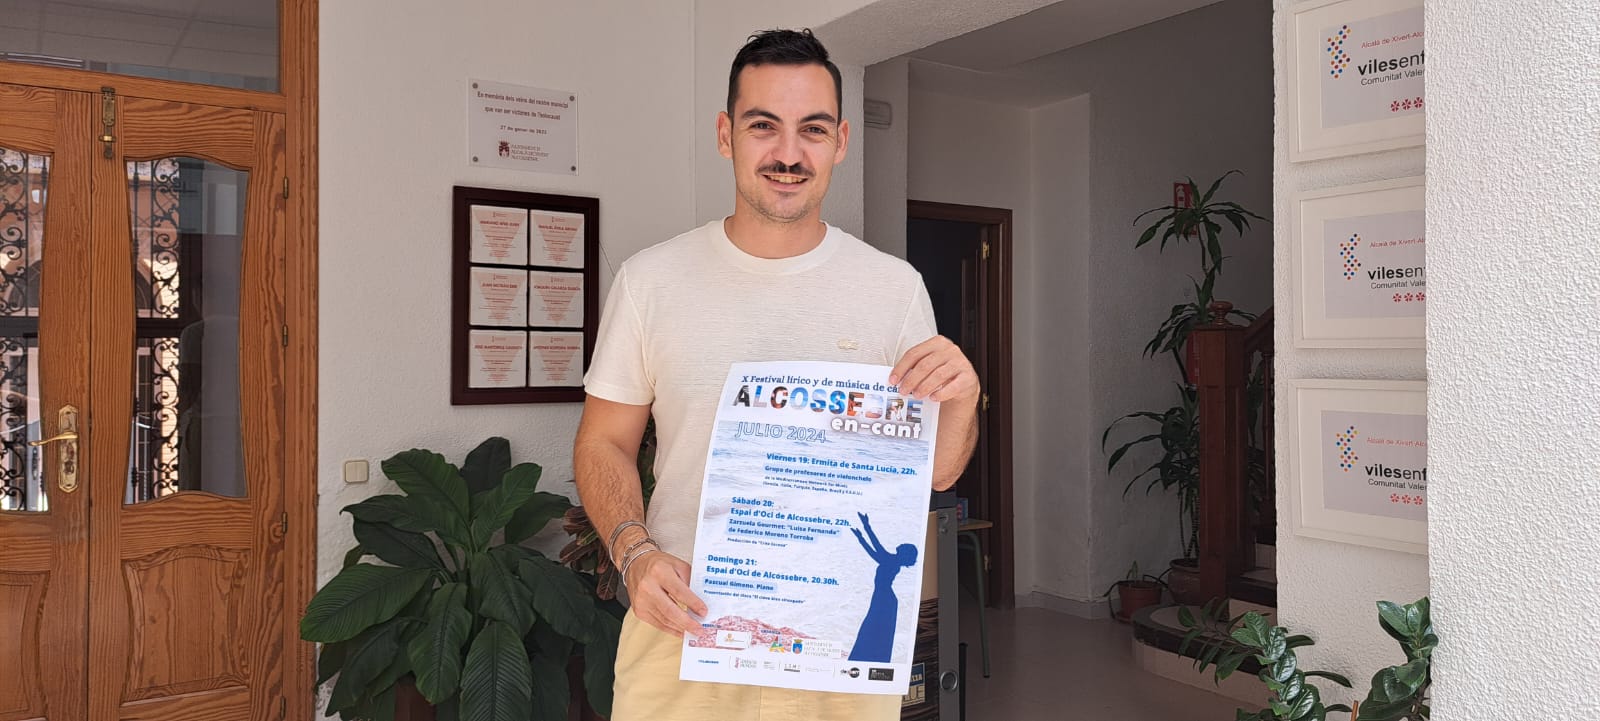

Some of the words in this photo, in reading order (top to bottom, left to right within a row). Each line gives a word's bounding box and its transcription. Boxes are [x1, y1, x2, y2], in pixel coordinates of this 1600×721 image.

[1360, 72, 1402, 86] Comunitat
[1368, 266, 1426, 280] vilesen
[1370, 281, 1408, 289] Comunitat
[750, 376, 785, 384] Festival
[786, 376, 811, 385] lírico
[812, 378, 820, 387] y
[822, 378, 833, 386] de
[836, 378, 870, 390] música
[873, 382, 885, 392] de
[733, 385, 924, 424] ALCOSSEBRE
[735, 422, 783, 439] JULIO
[786, 426, 826, 443] 2024
[831, 418, 922, 439] en-cant
[766, 453, 797, 463] Viernes
[798, 457, 810, 465] 19:
[812, 458, 838, 467] Ermita
[852, 462, 874, 471] Santa
[876, 465, 899, 474] Lucía,
[900, 468, 918, 476] 22h.
[764, 466, 784, 474] Grupo
[794, 468, 826, 478] profesores
[836, 474, 872, 482] violonchelo
[1368, 478, 1406, 489] Comunitat
[732, 496, 761, 506] Sábado
[763, 500, 774, 508] 20:
[730, 508, 752, 517] Espai
[753, 509, 774, 519] d'Oci
[786, 514, 833, 526] Alcossebre,
[834, 518, 852, 527] 22h.
[728, 519, 756, 527] Zarzuela
[756, 521, 786, 530] Gourmet:
[787, 524, 807, 532] "Luisa
[808, 526, 840, 535] Fernanda"
[737, 528, 764, 536] Federico
[764, 530, 788, 538] Moreno
[790, 533, 814, 541] Torroba
[708, 554, 744, 565] Domingo
[745, 558, 758, 566] 21:
[704, 578, 729, 586] Pascual
[706, 566, 727, 575] Espai
[729, 567, 750, 577] d'Oci
[763, 572, 809, 584] Alcossebre,
[811, 576, 840, 586] 20.30h.
